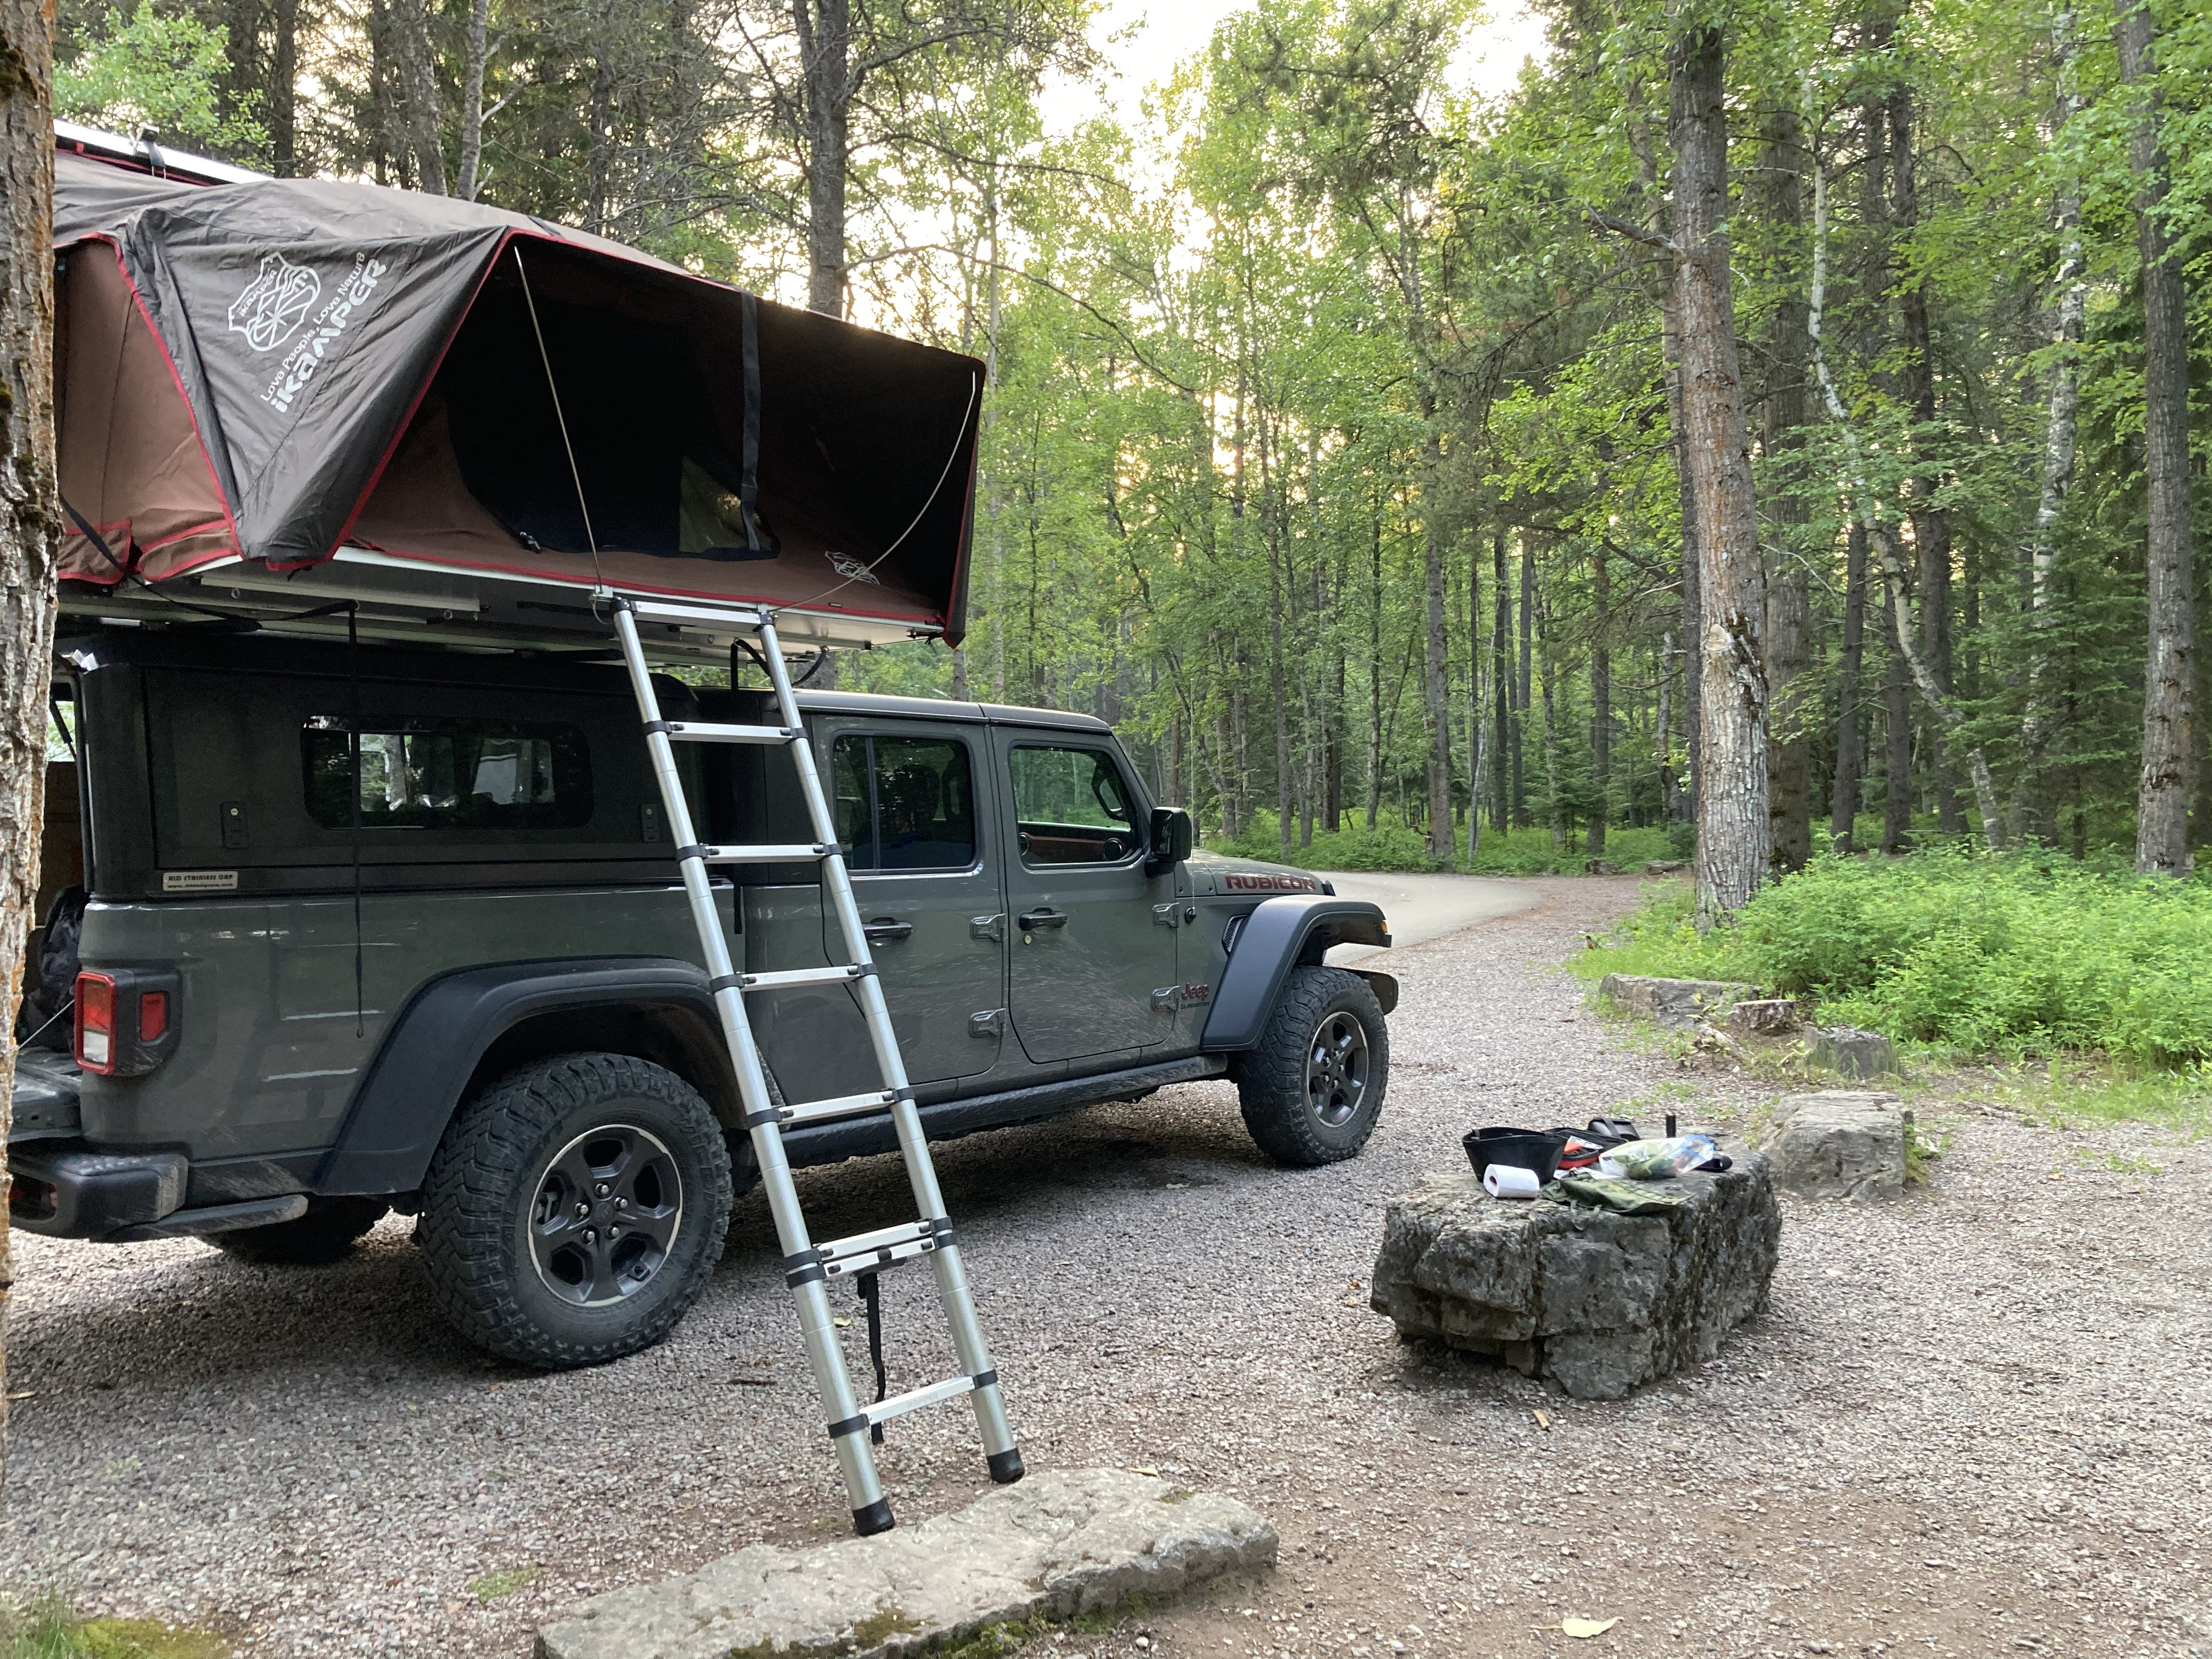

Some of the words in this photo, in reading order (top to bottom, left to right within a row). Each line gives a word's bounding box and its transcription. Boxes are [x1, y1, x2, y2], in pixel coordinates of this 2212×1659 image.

[260, 371, 285, 402] Love
[282, 326, 320, 370] People,
[313, 296, 340, 325] Love
[337, 251, 365, 296] Nature
[1224, 875, 1317, 891] RUBICON
[1181, 983, 1209, 1000] Jeep
